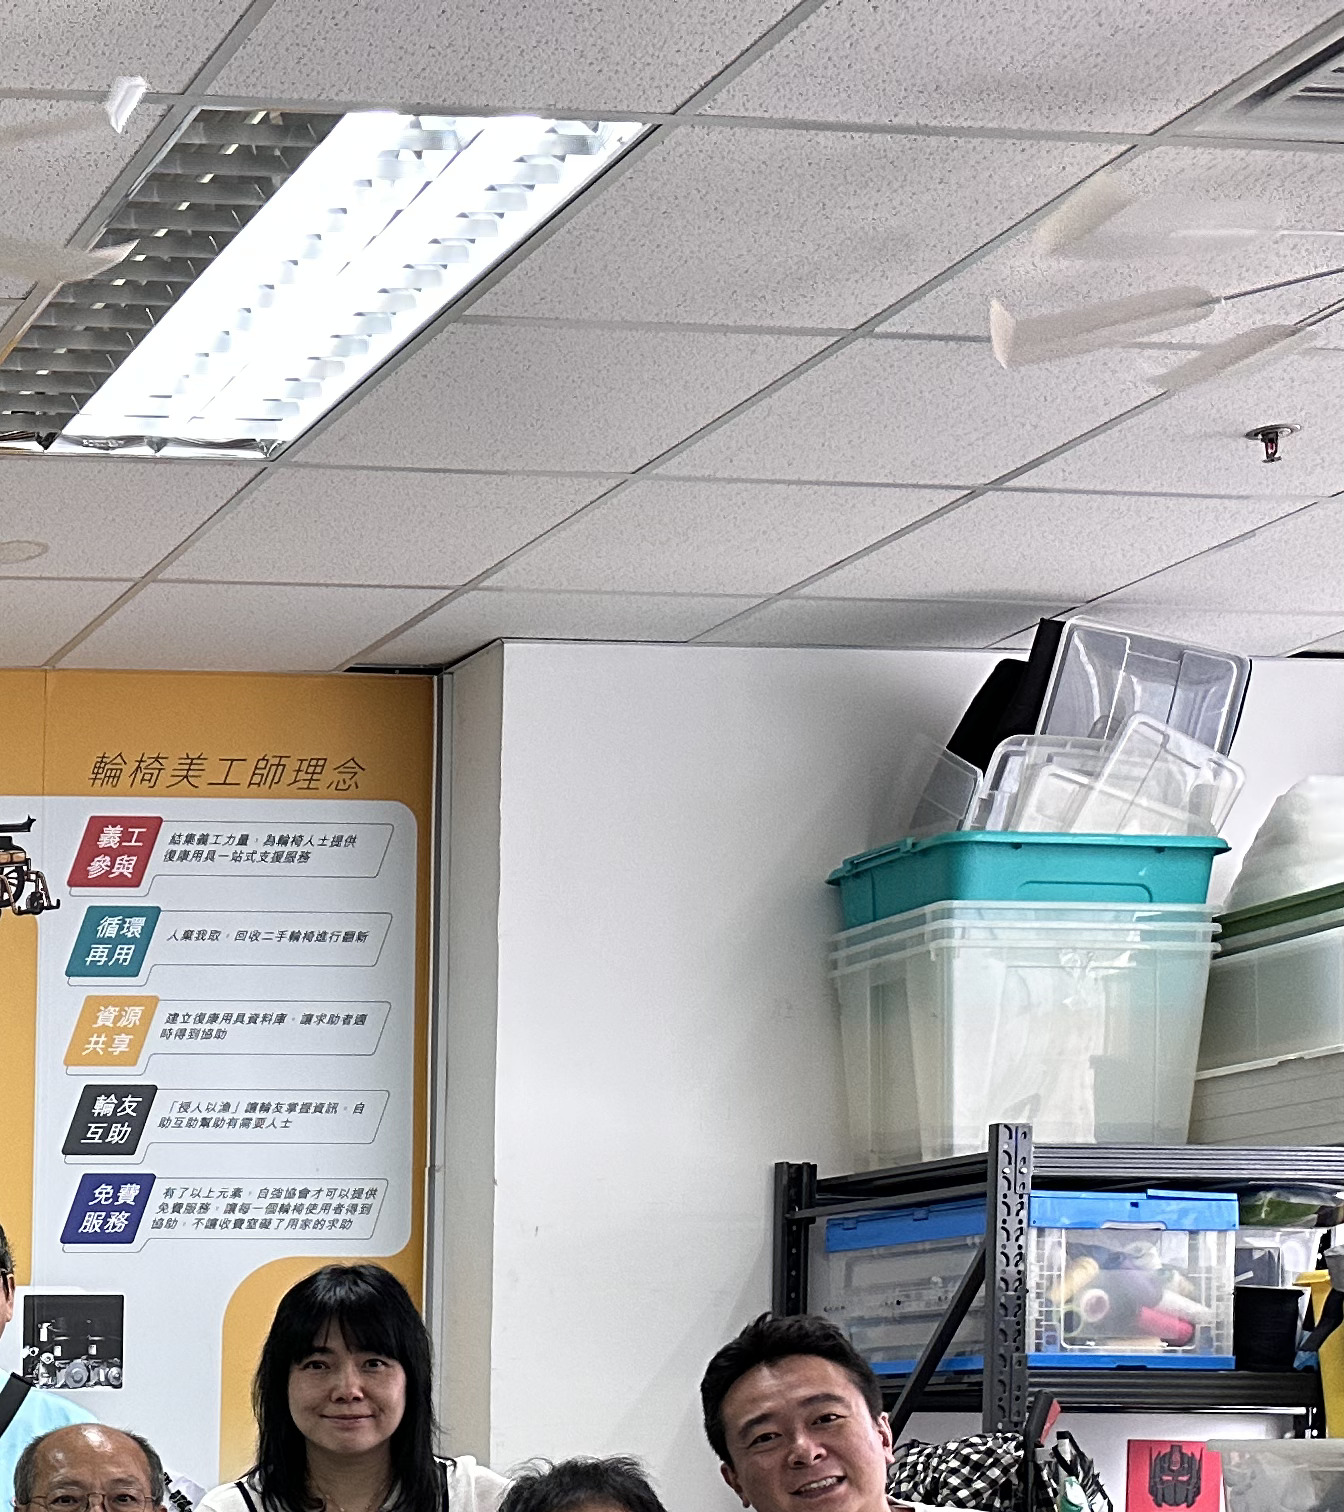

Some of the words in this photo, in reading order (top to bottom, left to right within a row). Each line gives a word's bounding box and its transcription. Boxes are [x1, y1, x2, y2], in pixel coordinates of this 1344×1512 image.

[88, 752, 367, 793] 輪椅美工師理念
[97, 825, 144, 849] 義工
[87, 855, 135, 879] 參與
[97, 915, 145, 940] 循環
[85, 944, 133, 967] 再用
[93, 1005, 142, 1029] 資源
[82, 1033, 131, 1055] 共享
[93, 1095, 142, 1118] 輪友
[81, 1122, 131, 1145] 互助
[93, 1183, 140, 1207] 免費
[79, 1211, 129, 1234] 服務
